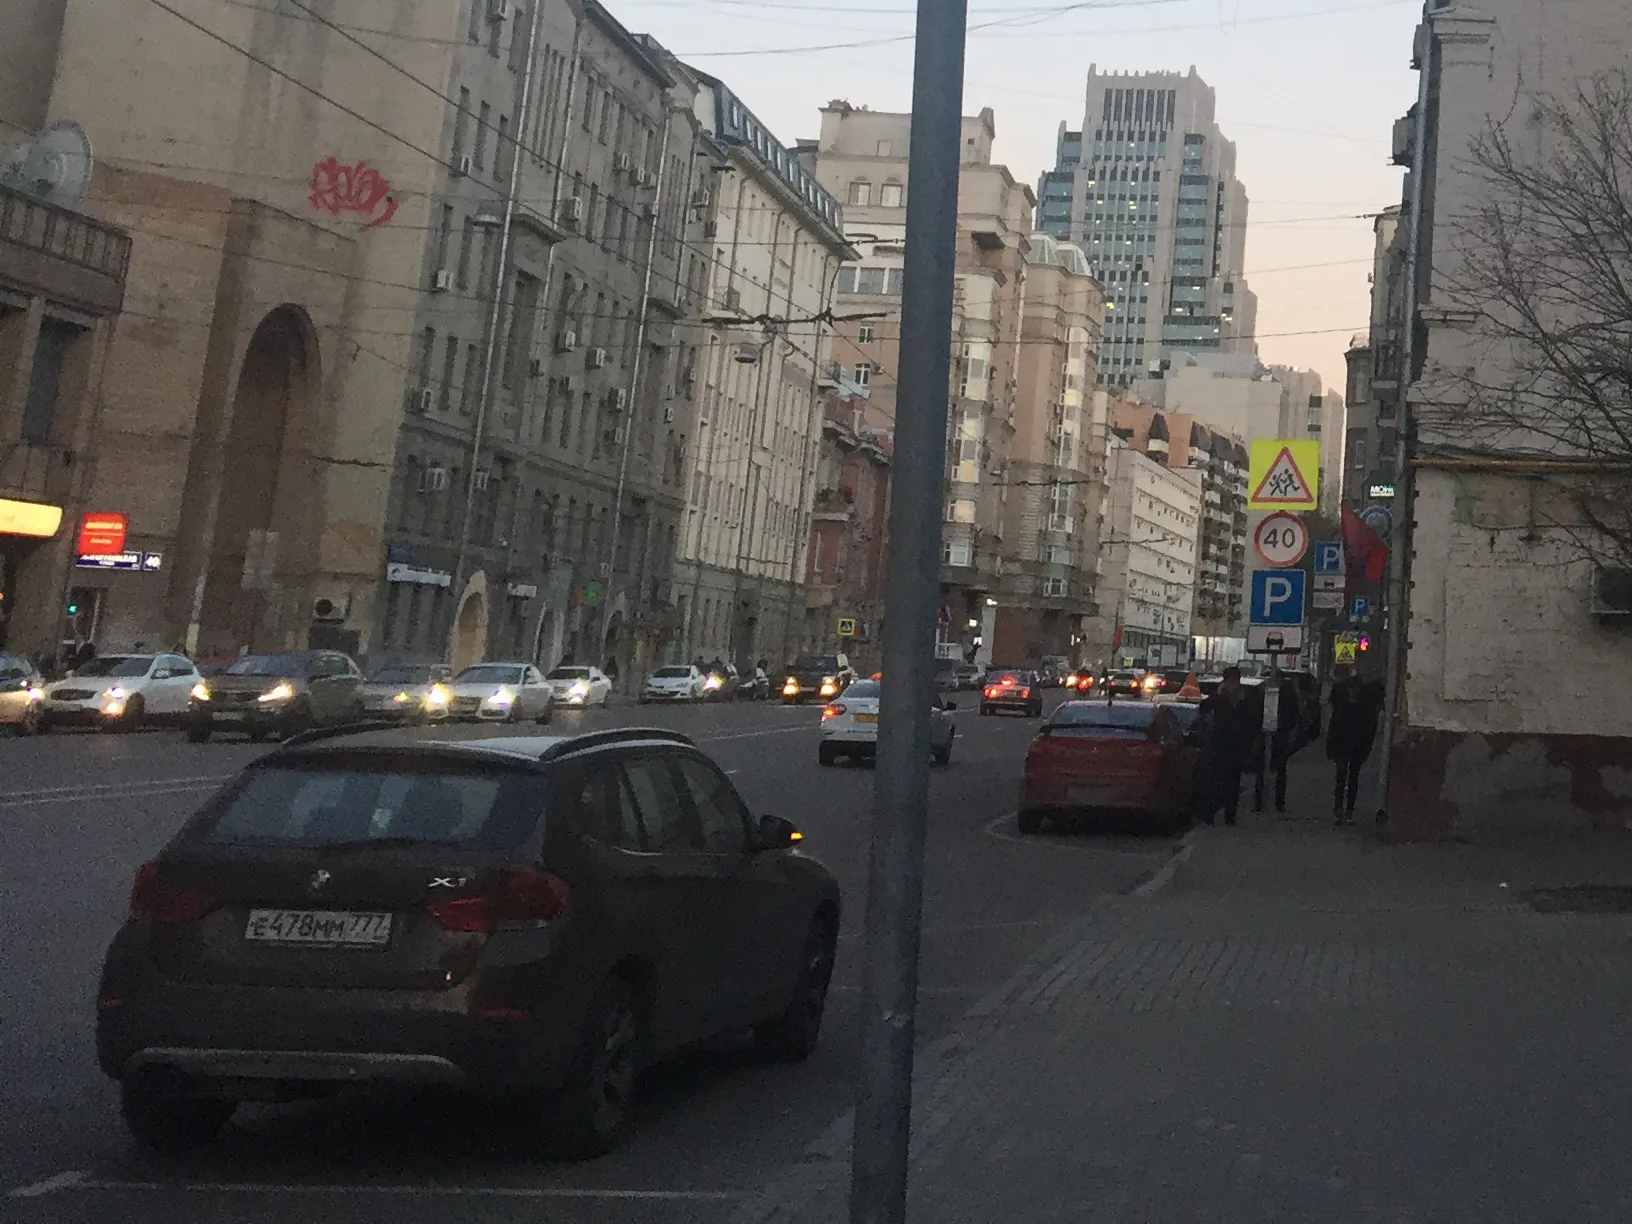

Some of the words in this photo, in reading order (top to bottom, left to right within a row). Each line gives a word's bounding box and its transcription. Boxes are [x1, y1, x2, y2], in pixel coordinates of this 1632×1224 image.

[1263, 527, 1296, 549] 40
[1323, 547, 1340, 571] P
[1263, 577, 1292, 617] P
[1354, 598, 1365, 612] P
